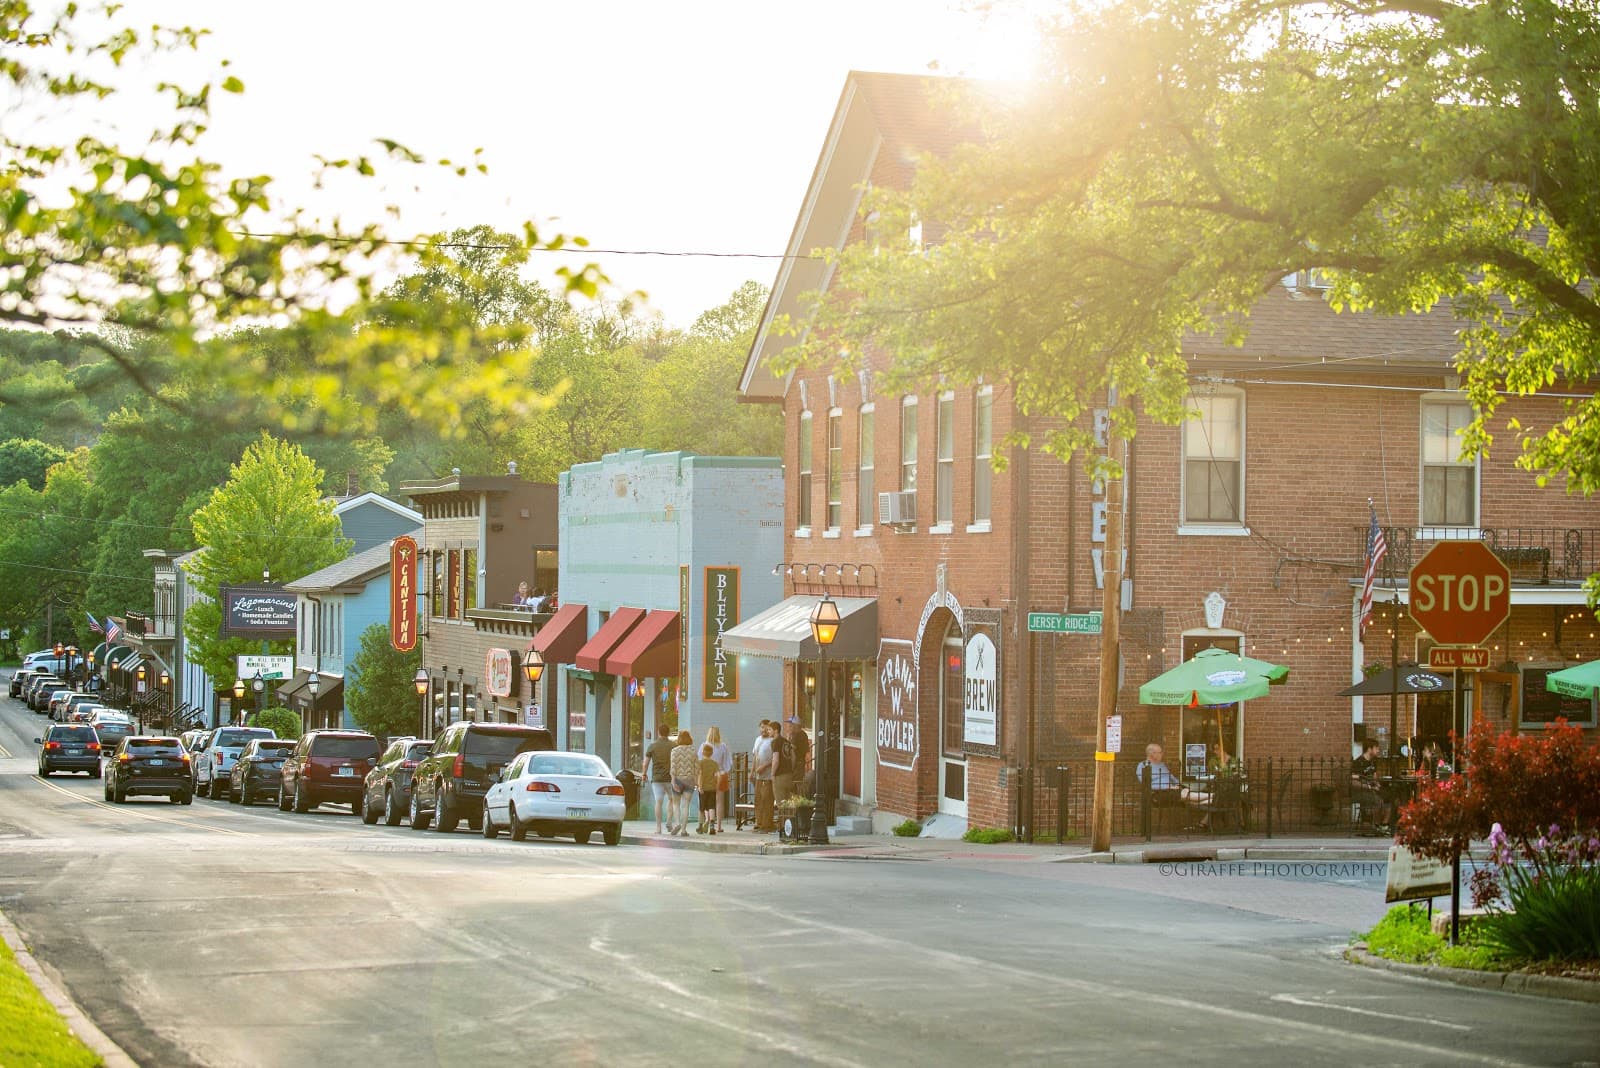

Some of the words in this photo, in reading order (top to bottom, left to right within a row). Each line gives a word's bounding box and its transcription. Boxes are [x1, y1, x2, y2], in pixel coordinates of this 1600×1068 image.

[400, 564, 410, 644] CANTINA
[1415, 574, 1505, 612] STOP
[1030, 616, 1062, 629] JERSEY
[1064, 617, 1089, 630] RIDGE
[1090, 616, 1098, 624] RD
[1434, 652, 1455, 664] ALL
[1462, 652, 1485, 664] WAY
[881, 653, 916, 702] FRANK
[966, 677, 995, 712] BREW
[891, 686, 904, 716] W.
[878, 718, 914, 753] BOYLER
